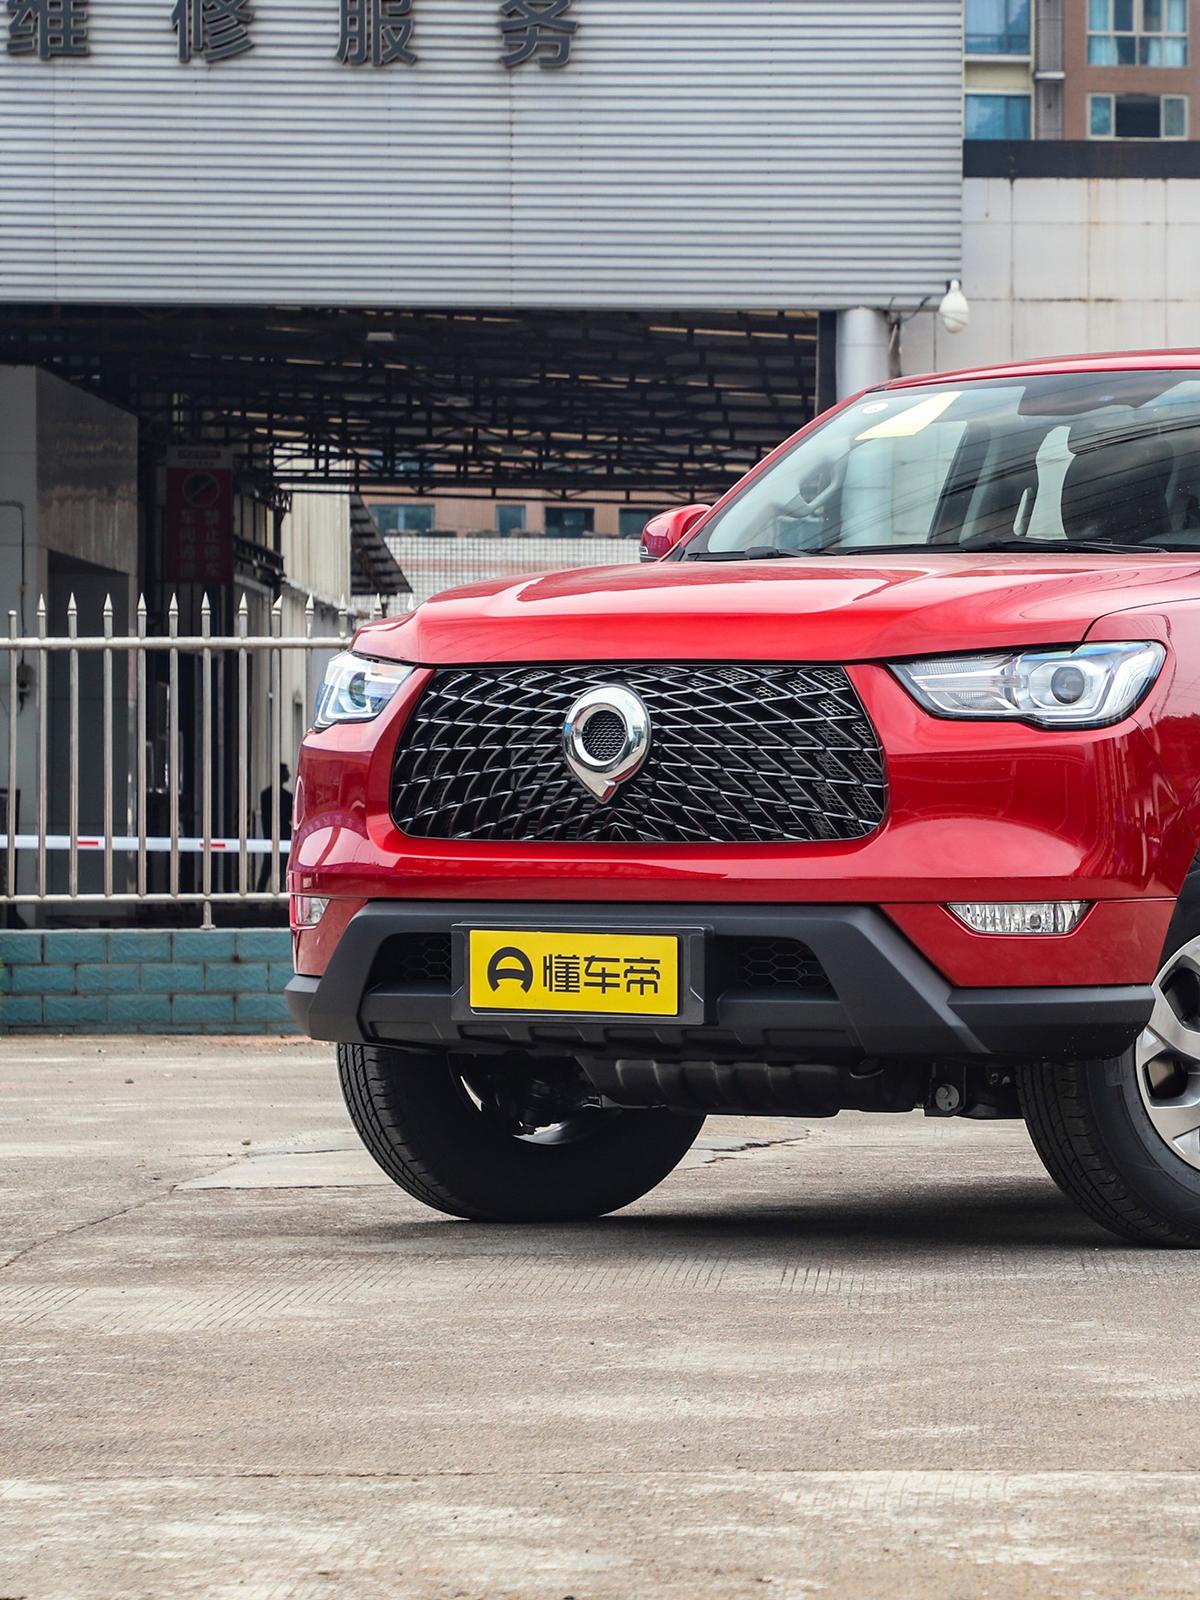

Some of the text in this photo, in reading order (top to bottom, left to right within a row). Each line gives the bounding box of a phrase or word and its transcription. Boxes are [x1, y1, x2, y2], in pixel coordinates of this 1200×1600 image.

[6, 0, 580, 68] 维修服务
[542, 953, 661, 996] 懂车帝
